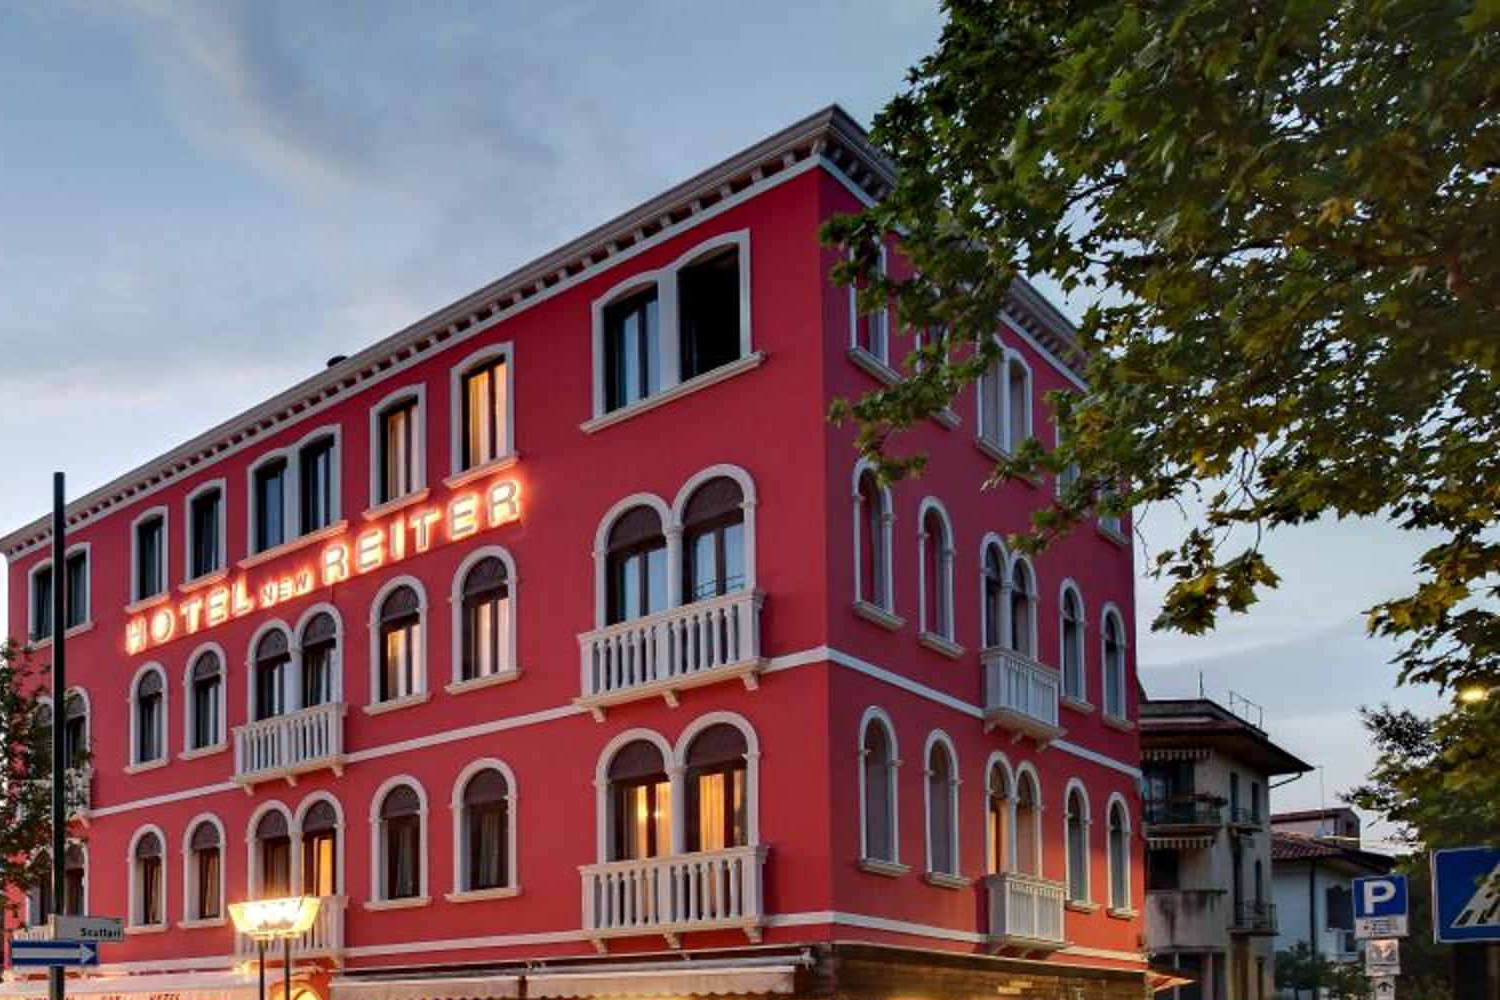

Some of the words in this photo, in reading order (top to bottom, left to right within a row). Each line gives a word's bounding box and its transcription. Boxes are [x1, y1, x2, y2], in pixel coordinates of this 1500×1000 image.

[125, 572, 253, 656] HOTEL
[321, 479, 520, 586] REITER
[1363, 880, 1396, 915] P
